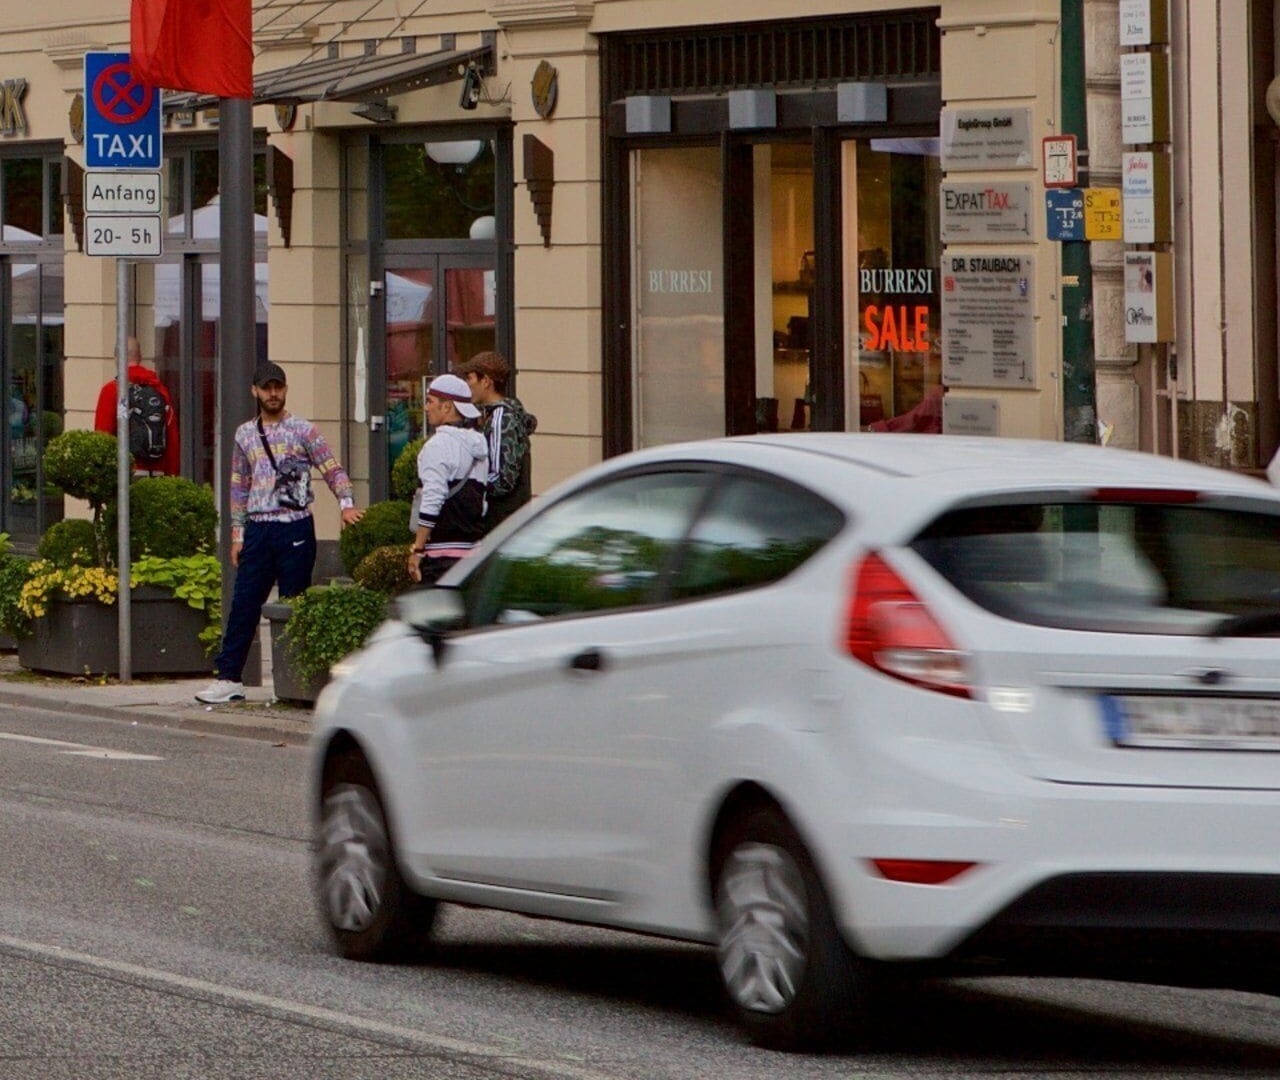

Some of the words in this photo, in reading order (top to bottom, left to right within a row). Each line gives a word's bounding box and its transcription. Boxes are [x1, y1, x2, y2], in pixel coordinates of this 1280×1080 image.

[93, 133, 154, 158] TAXI
[92, 185, 156, 205] Anfang
[93, 229, 122, 245] 20-
[970, 257, 1022, 273] STAUBACH
[648, 270, 713, 294] BURRESI
[859, 268, 934, 294] BURRESI
[864, 304, 930, 351] SALE
